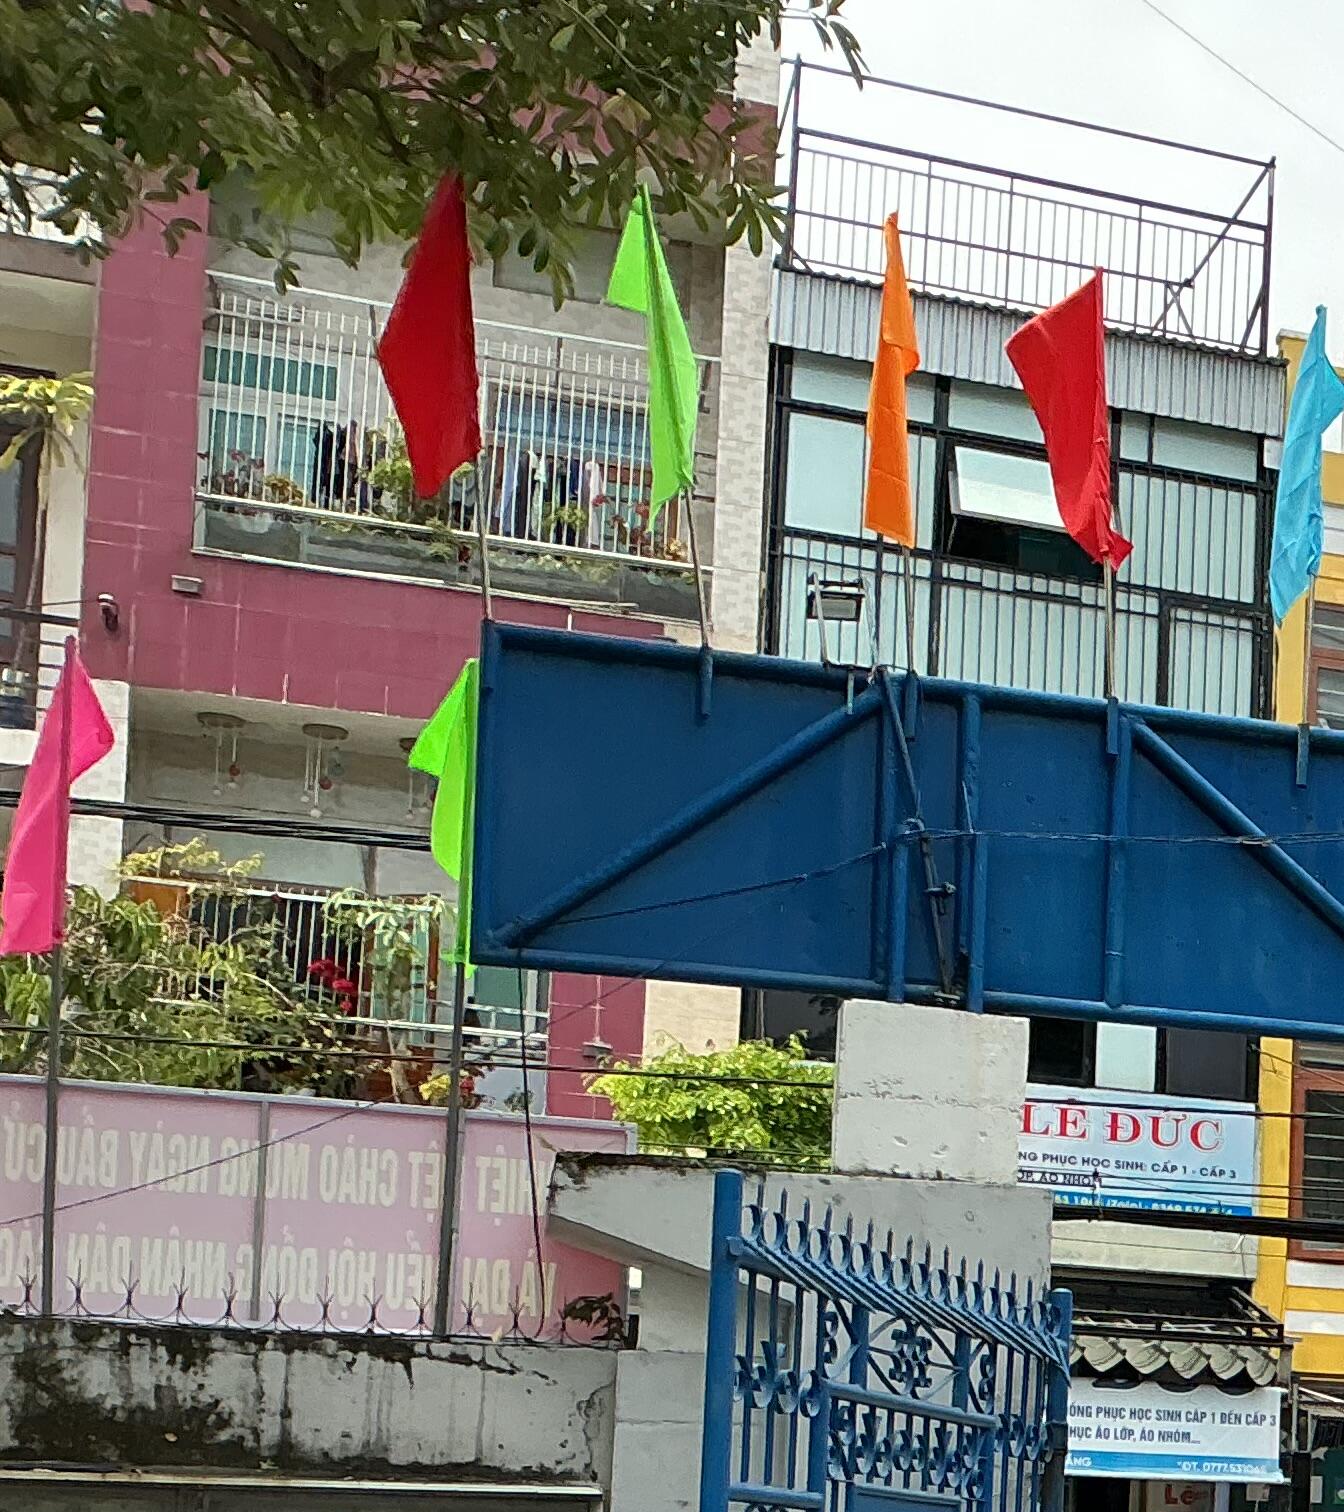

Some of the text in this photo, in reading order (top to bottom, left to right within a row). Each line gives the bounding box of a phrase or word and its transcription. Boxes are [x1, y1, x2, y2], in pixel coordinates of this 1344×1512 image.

[1042, 1153, 1078, 1168] PHỤC
[1096, 1406, 1126, 1423] PHỤC
[1130, 1408, 1152, 1422] HỌC
[1155, 1409, 1182, 1422] SINH
[1245, 1410, 1267, 1426] CẤP
[1270, 1415, 1276, 1426] 3
[1069, 1426, 1092, 1440] HỤC
